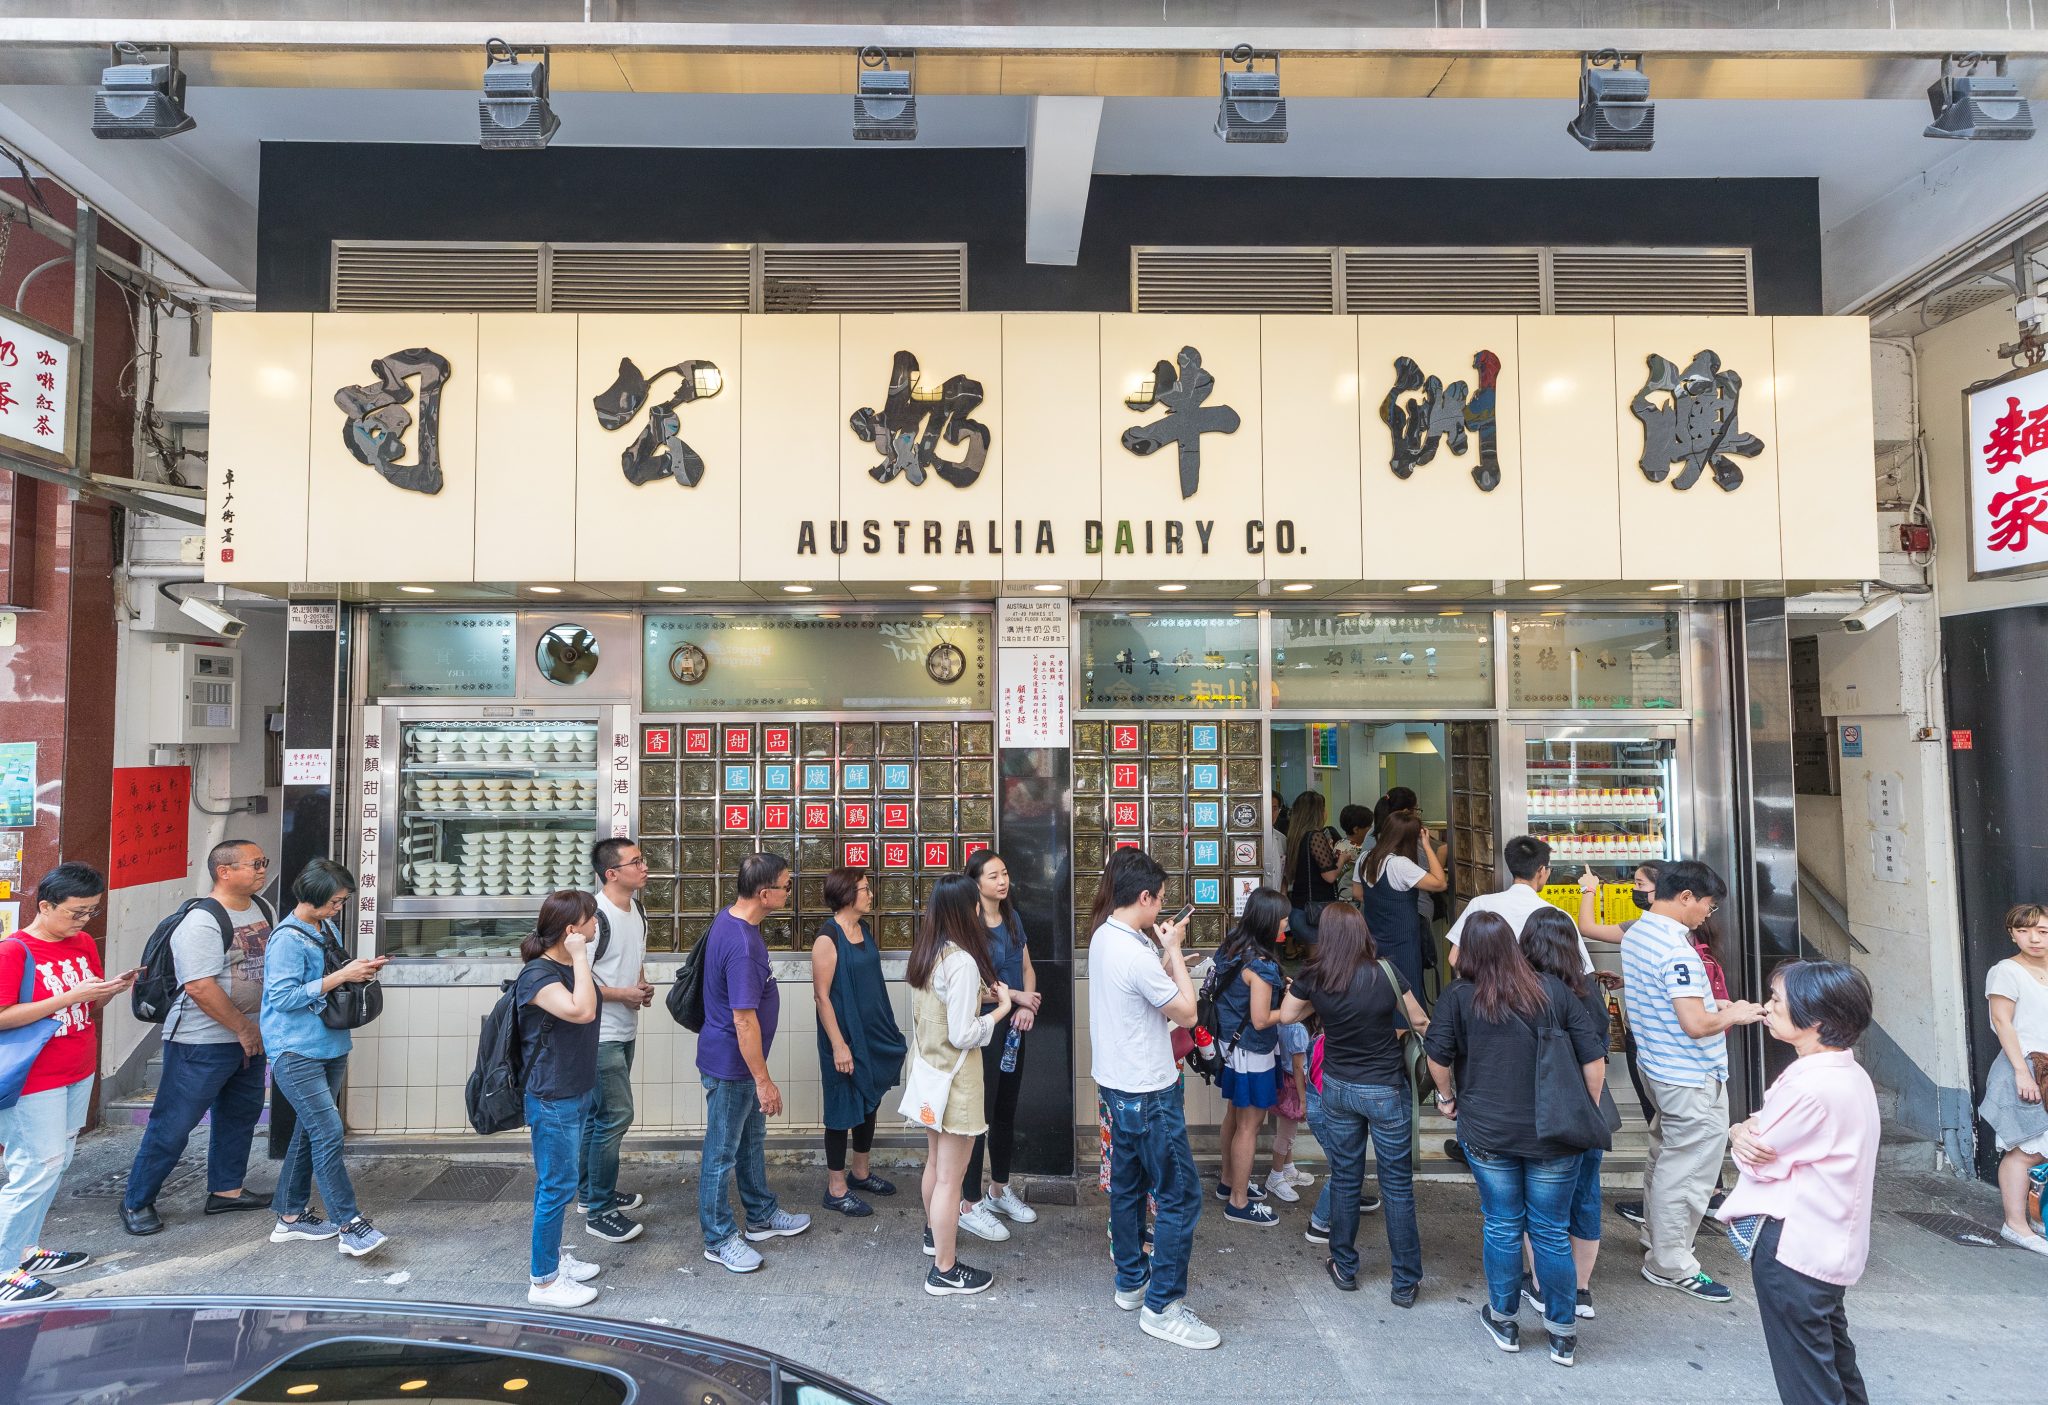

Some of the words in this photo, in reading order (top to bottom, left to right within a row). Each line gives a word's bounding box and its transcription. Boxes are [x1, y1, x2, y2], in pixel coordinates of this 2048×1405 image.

[797, 520, 1055, 555] AUSTRALIA
[1085, 520, 1215, 555] DAIRY
[1246, 520, 1307, 555] CO.
[1006, 602, 1034, 610] AUSTRALIA
[1035, 602, 1051, 610] DAIRY
[649, 732, 786, 751] 香潤甜品
[730, 767, 906, 788] 蛋白燉鮮奶
[1116, 729, 1136, 848] 杏汁燉
[1196, 729, 1216, 901] 蛋白燉鮮奶
[359, 734, 380, 935] 養顏甜品杏汁燉雞蛋
[1673, 963, 1691, 986] 3
